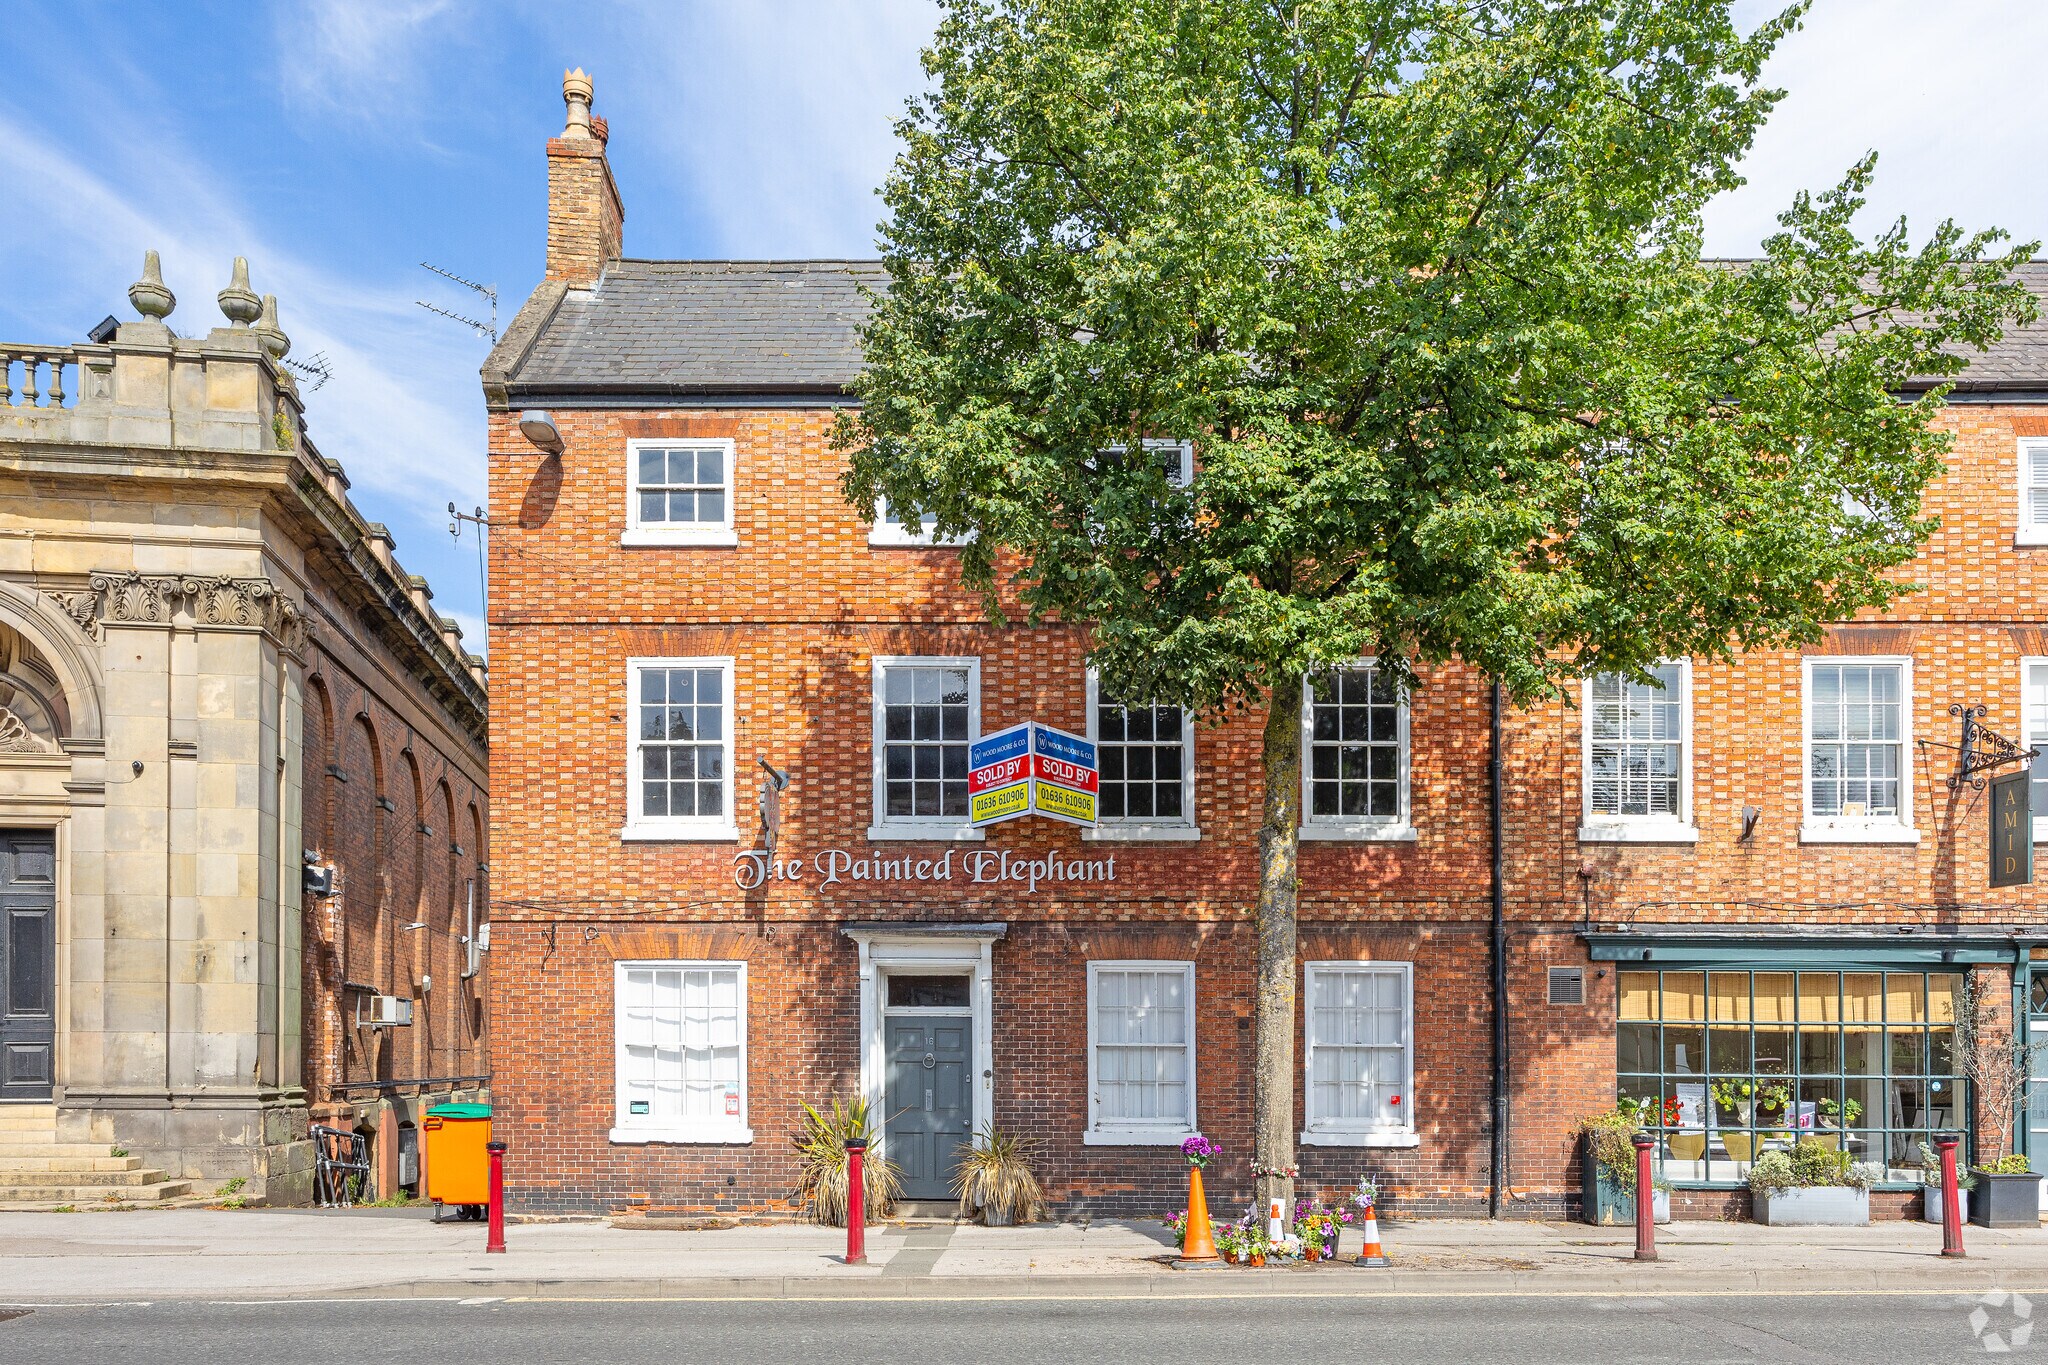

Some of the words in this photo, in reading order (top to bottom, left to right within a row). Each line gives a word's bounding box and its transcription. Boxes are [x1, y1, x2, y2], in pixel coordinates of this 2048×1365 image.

[982, 748, 997, 758] WOOD
[996, 742, 1013, 754] MOORE
[1048, 741, 1063, 751] WOOD
[1064, 746, 1080, 756] MOORE
[977, 765, 1004, 785] SOLD
[1007, 758, 1021, 776] BY
[1042, 759, 1074, 779] SOLD
[1076, 768, 1091, 784] BY
[976, 796, 996, 811] 01636
[998, 788, 1024, 806] 610906
[1041, 788, 1063, 804] 01636
[1066, 794, 1091, 810] 610906
[2004, 789, 2018, 875] AMID
[733, 849, 802, 890] The
[814, 849, 956, 894] Painted
[963, 849, 1118, 894] Elephant
[925, 1037, 934, 1045] 16
